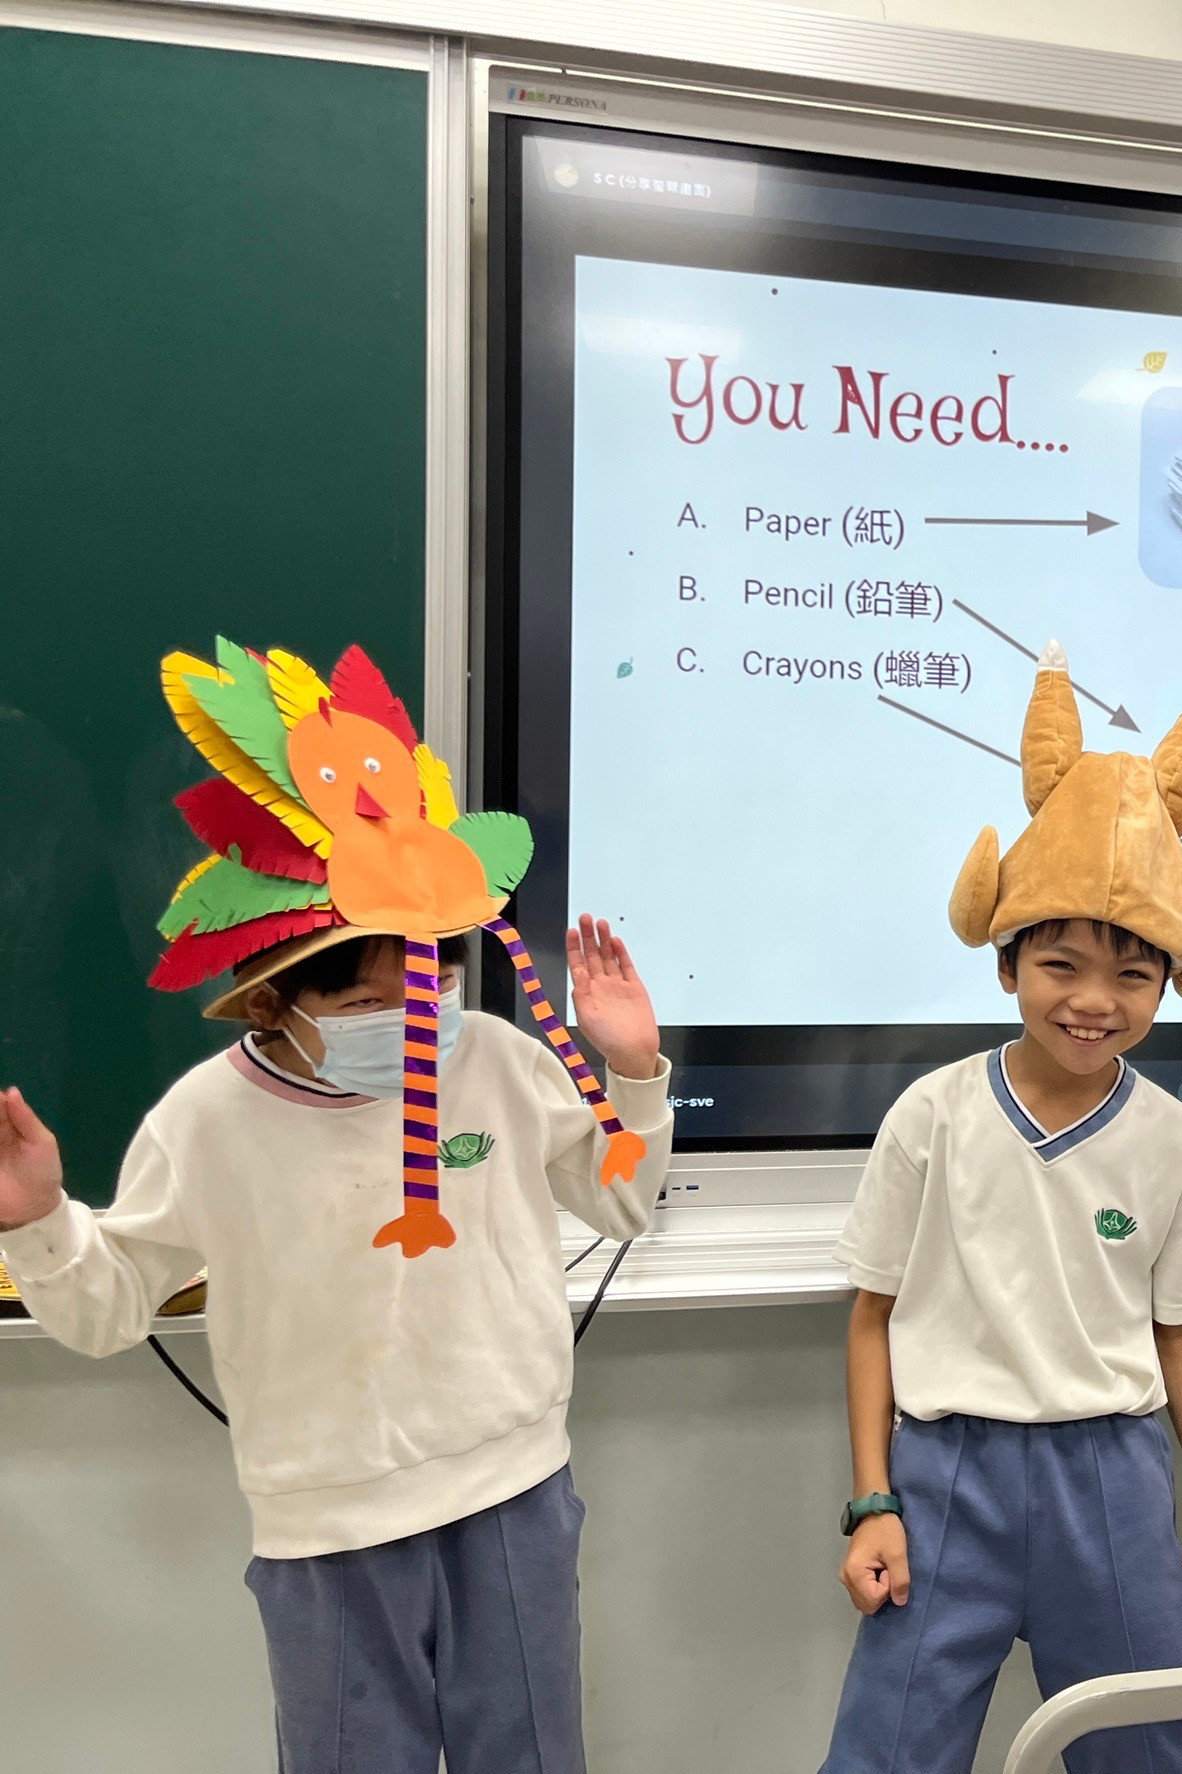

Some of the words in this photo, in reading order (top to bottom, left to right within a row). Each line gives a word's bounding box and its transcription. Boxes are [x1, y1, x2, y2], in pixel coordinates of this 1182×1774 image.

[548, 94, 607, 111] PERSONA
[665, 353, 808, 444] You
[832, 365, 1069, 453] Need....
[677, 503, 707, 529] A.
[744, 506, 832, 541] Paper
[841, 505, 906, 550] (紙)
[678, 575, 706, 602] B.
[743, 579, 834, 609] Pencil
[845, 579, 944, 622] (鉛筆)
[676, 647, 705, 674] C.
[742, 650, 863, 684] Crayons
[873, 651, 973, 694] (蠟筆)
